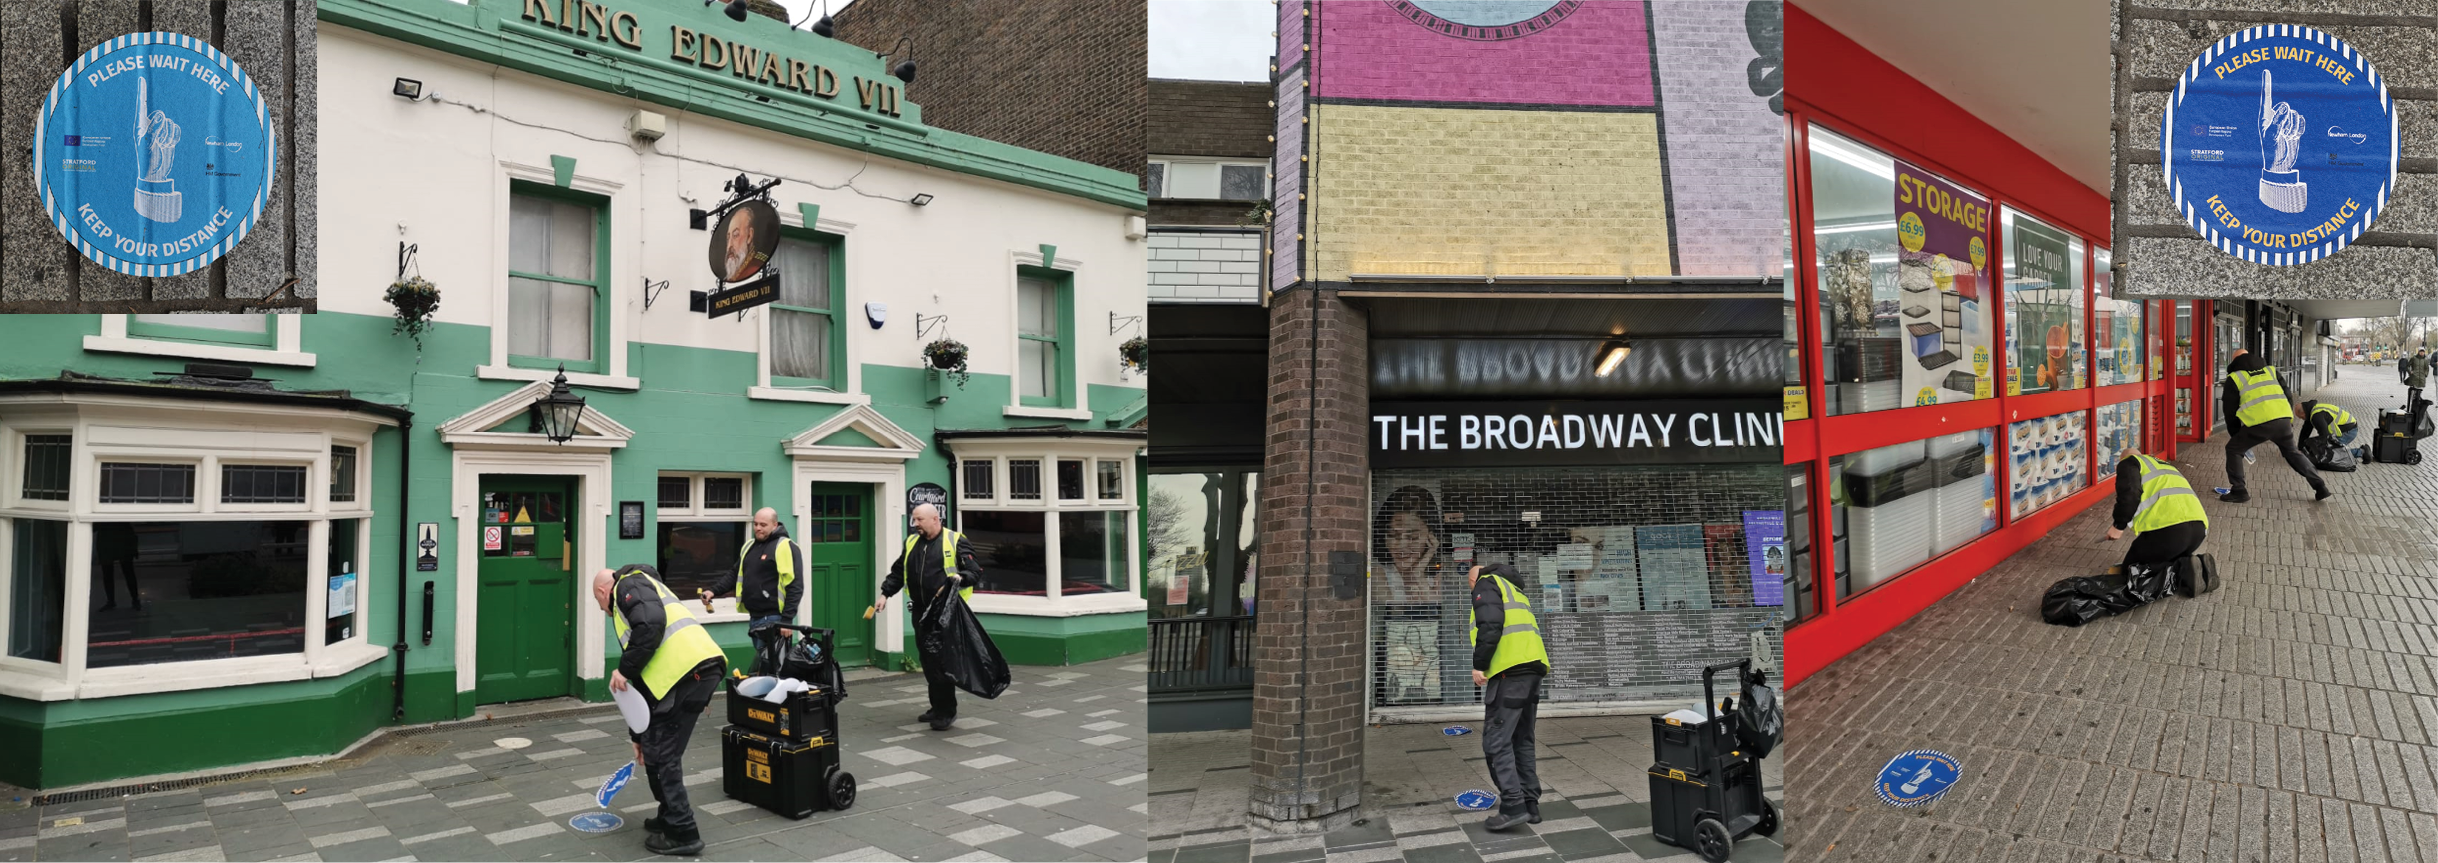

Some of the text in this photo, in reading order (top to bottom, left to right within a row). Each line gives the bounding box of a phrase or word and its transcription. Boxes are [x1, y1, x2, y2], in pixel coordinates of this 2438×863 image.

[87, 54, 231, 96] PLEASE WAIT HERE
[671, 24, 841, 99] EDWARD
[853, 75, 901, 118] VII
[2214, 46, 2356, 86] PLEASE WAIT HERE
[1899, 173, 1986, 233] STORAGE
[77, 202, 234, 258] KEEP YOUR DISTANCE
[1900, 220, 1924, 237] £6.99
[2206, 194, 2361, 249] KEEP YOUR DISTANCE
[1970, 246, 1985, 257] £7.99
[2022, 242, 2063, 272] LOVE YOUR
[2022, 266, 2052, 289] GARDEN
[715, 285, 771, 309] KING EDWARD VII
[1973, 353, 1989, 363] £3.99
[1915, 395, 1937, 407] £4.99
[1373, 414, 1448, 451] THE
[1460, 411, 1676, 451] BROADWAY
